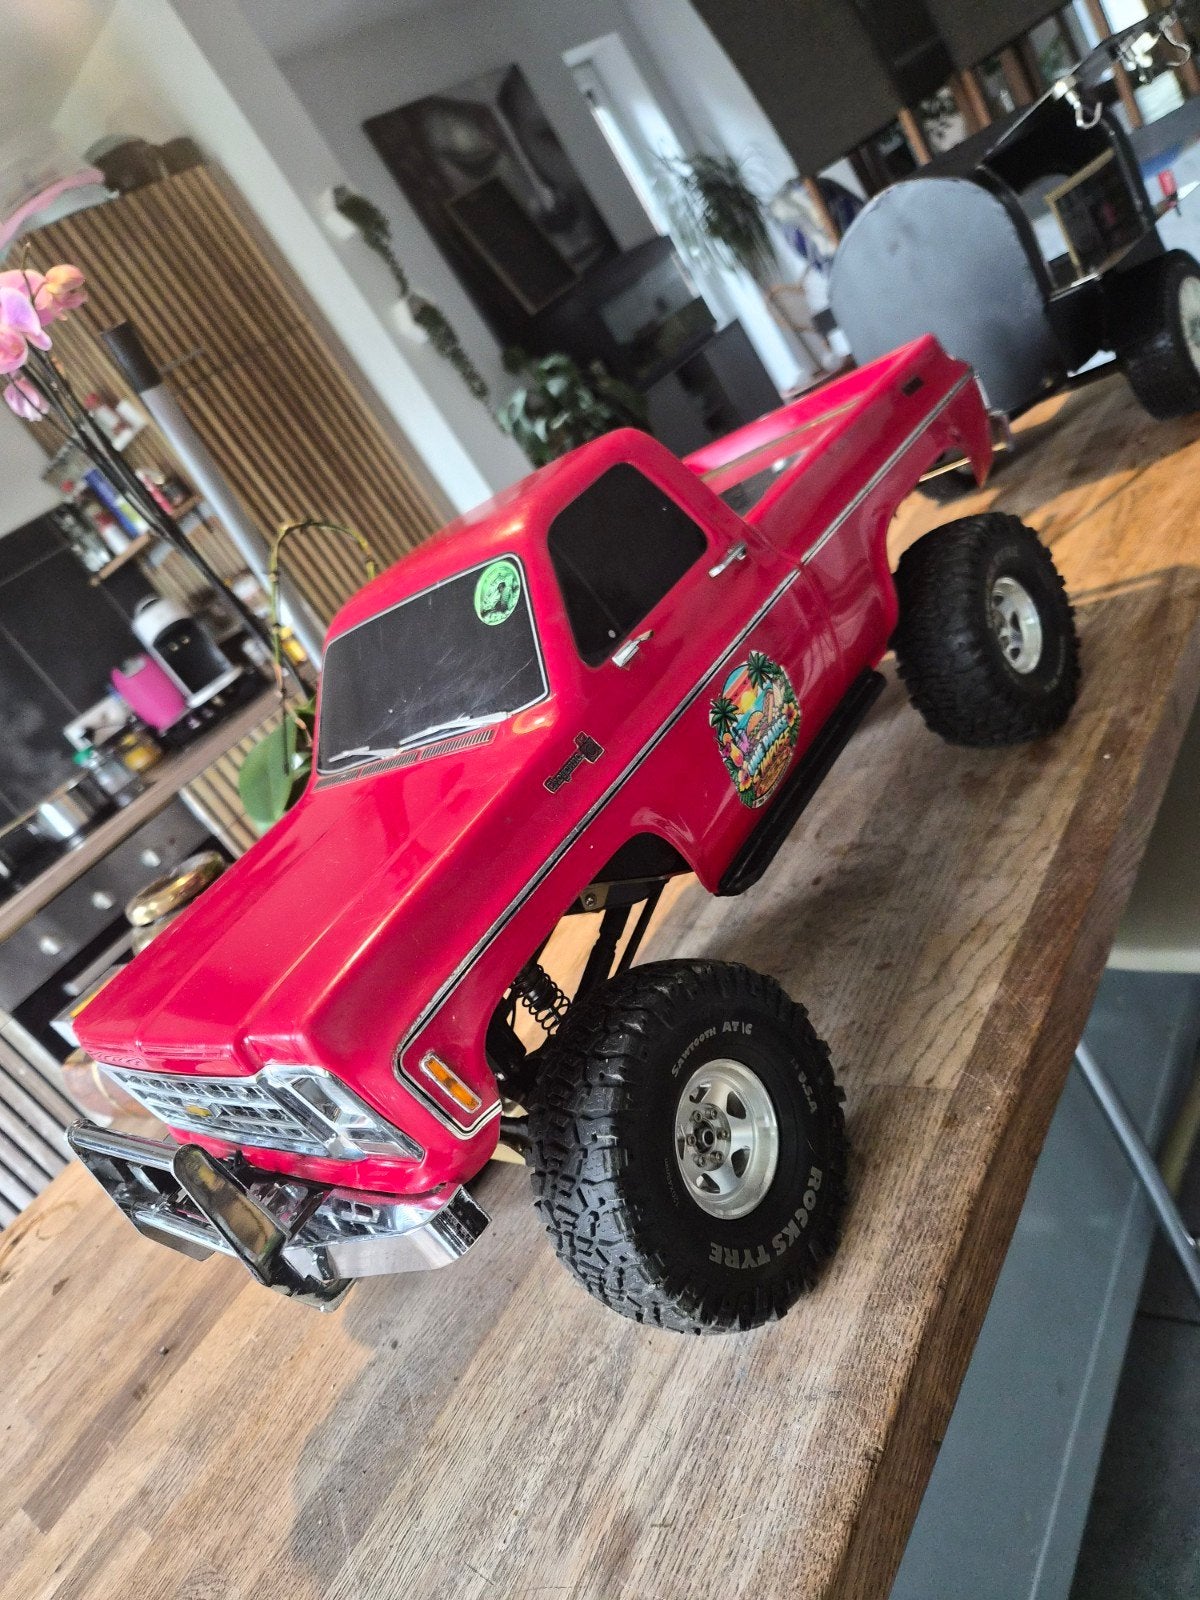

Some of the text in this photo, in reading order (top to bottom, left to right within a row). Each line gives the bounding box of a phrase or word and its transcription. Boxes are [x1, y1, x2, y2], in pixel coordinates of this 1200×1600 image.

[671, 1026, 717, 1078] SAWTOOTH
[708, 1166, 822, 1269] ROCKS TYRE
